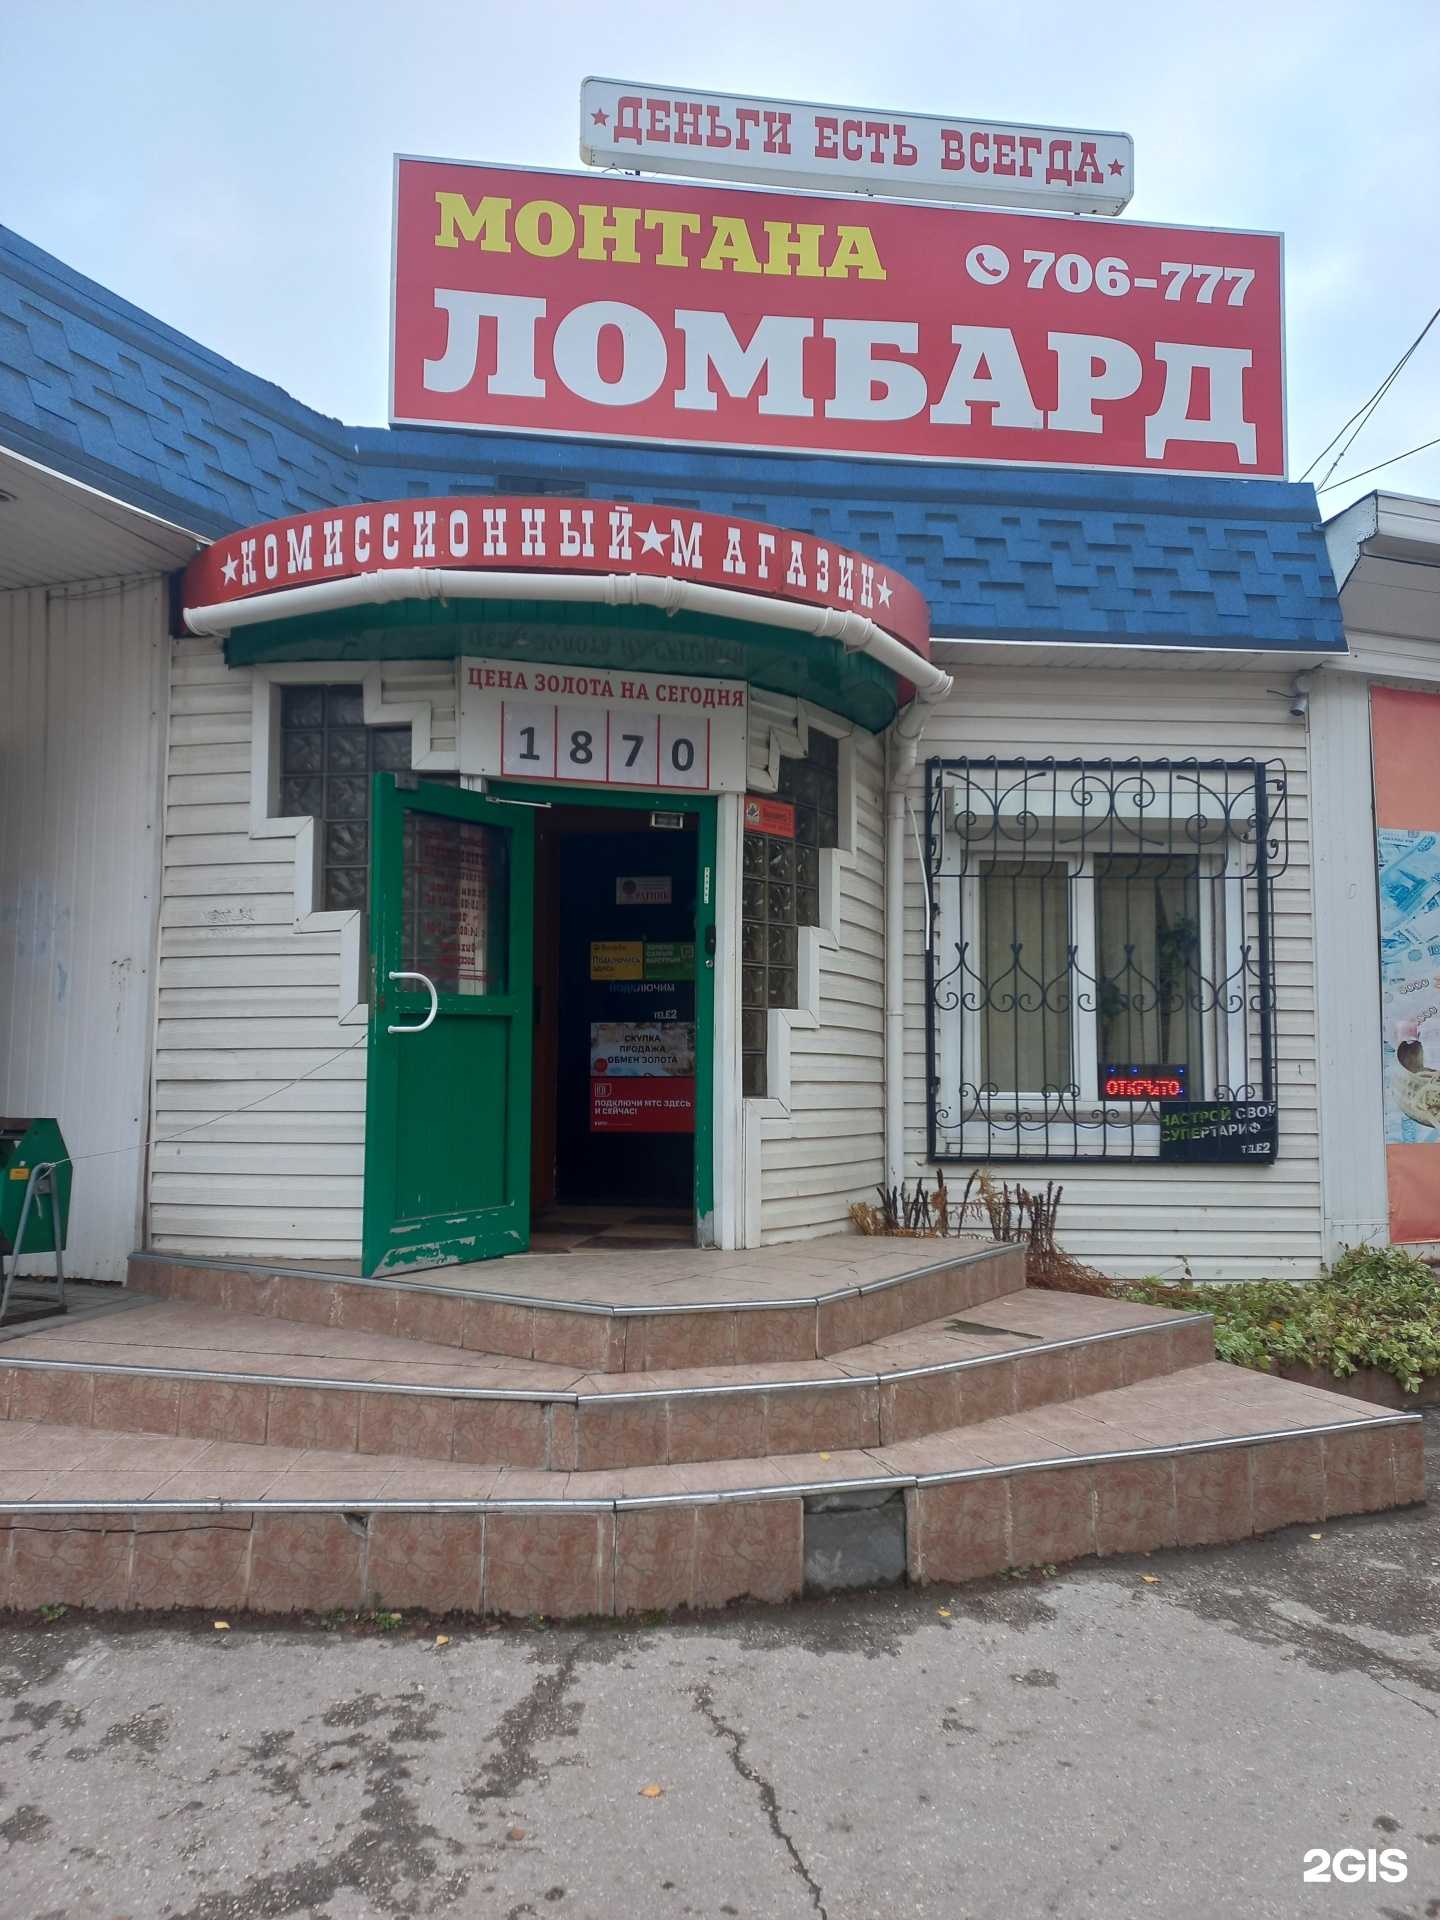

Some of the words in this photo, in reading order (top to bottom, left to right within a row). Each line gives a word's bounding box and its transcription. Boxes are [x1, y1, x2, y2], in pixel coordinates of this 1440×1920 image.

[613, 95, 792, 155] ДЕНЬГИ
[814, 116, 919, 167] ЕСТЬ
[940, 128, 1106, 187] ВСЕГДА
[434, 191, 888, 281] МОНТАНА
[1023, 249, 1256, 307] 706-777
[422, 287, 1259, 467] ЛОМБАРД
[239, 505, 634, 586] КОМИССИОННЫЙ
[670, 519, 877, 608] МАГАЗИН
[468, 667, 529, 690] ЦЕНА
[534, 673, 615, 698] ЗОЛОТА
[620, 681, 650, 700] НА
[655, 684, 745, 709] СЕГОДНЯ
[619, 1045, 666, 1054] ПРОДАЖА
[624, 1034, 661, 1043] СКУПКА
[607, 1055, 640, 1065] ОБМЕН
[642, 1055, 678, 1065] ЗОЛОТА
[1105, 1079, 1182, 1096] ОТКРЫТО
[594, 1099, 642, 1108] ПОДКЛЮЧИ
[644, 1099, 662, 1107] МТС
[663, 1099, 692, 1109] ЗДЕСЬ
[1161, 1105, 1232, 1127] НАСТРОЙ
[1235, 1102, 1276, 1120] СВОЙ
[1161, 1121, 1262, 1142] СУПЕРТАРИФ
